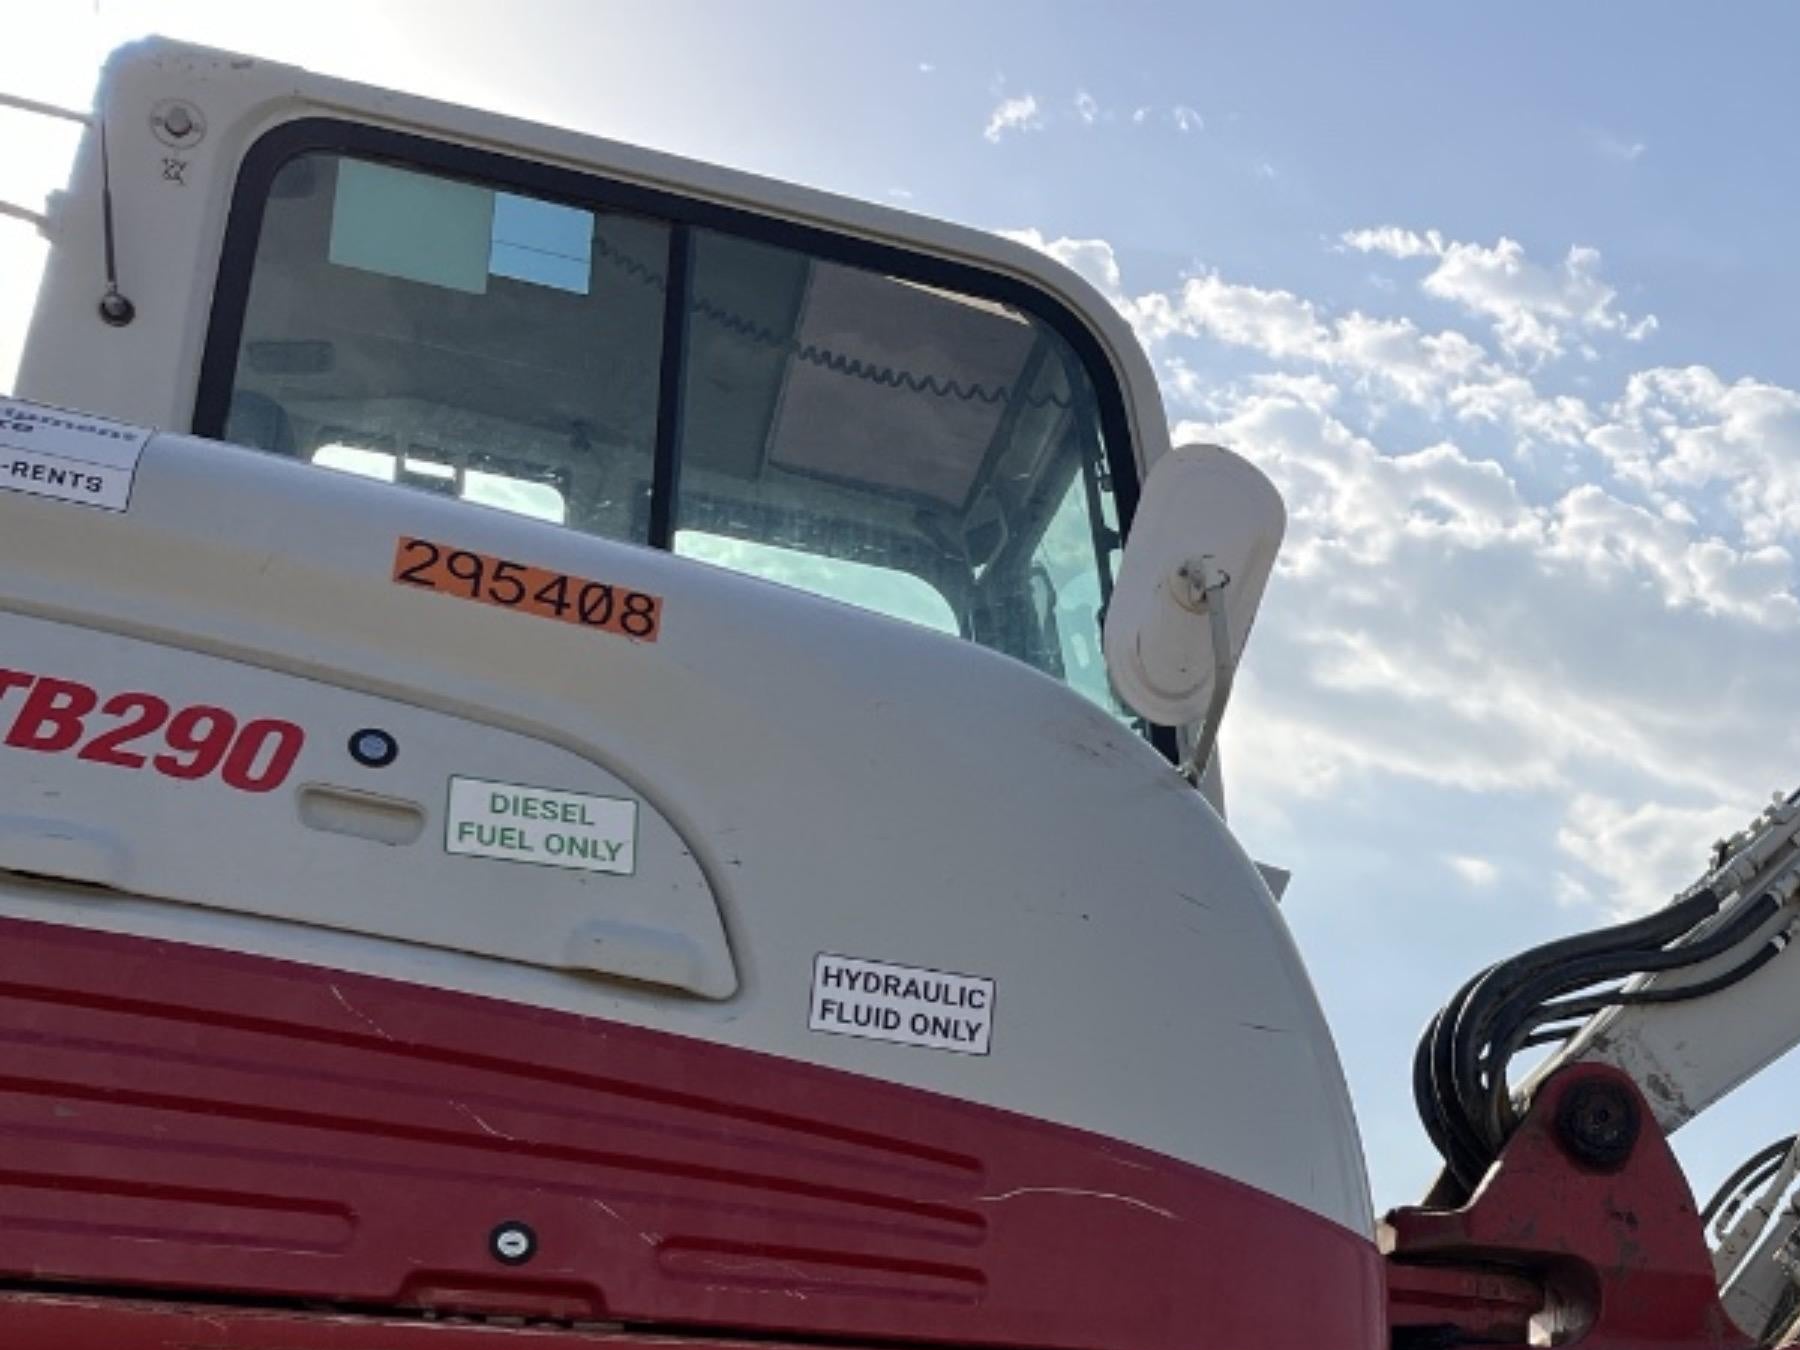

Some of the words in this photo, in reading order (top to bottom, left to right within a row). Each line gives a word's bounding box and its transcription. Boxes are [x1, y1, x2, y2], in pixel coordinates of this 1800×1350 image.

[399, 537, 657, 639] 295408
[490, 792, 596, 827] DIESEL
[457, 821, 535, 853] FUEL
[545, 832, 623, 862] ONLY
[822, 965, 986, 1010] HYDRAULIC
[819, 999, 901, 1031] FLUID
[910, 1013, 983, 1042] ONLY
